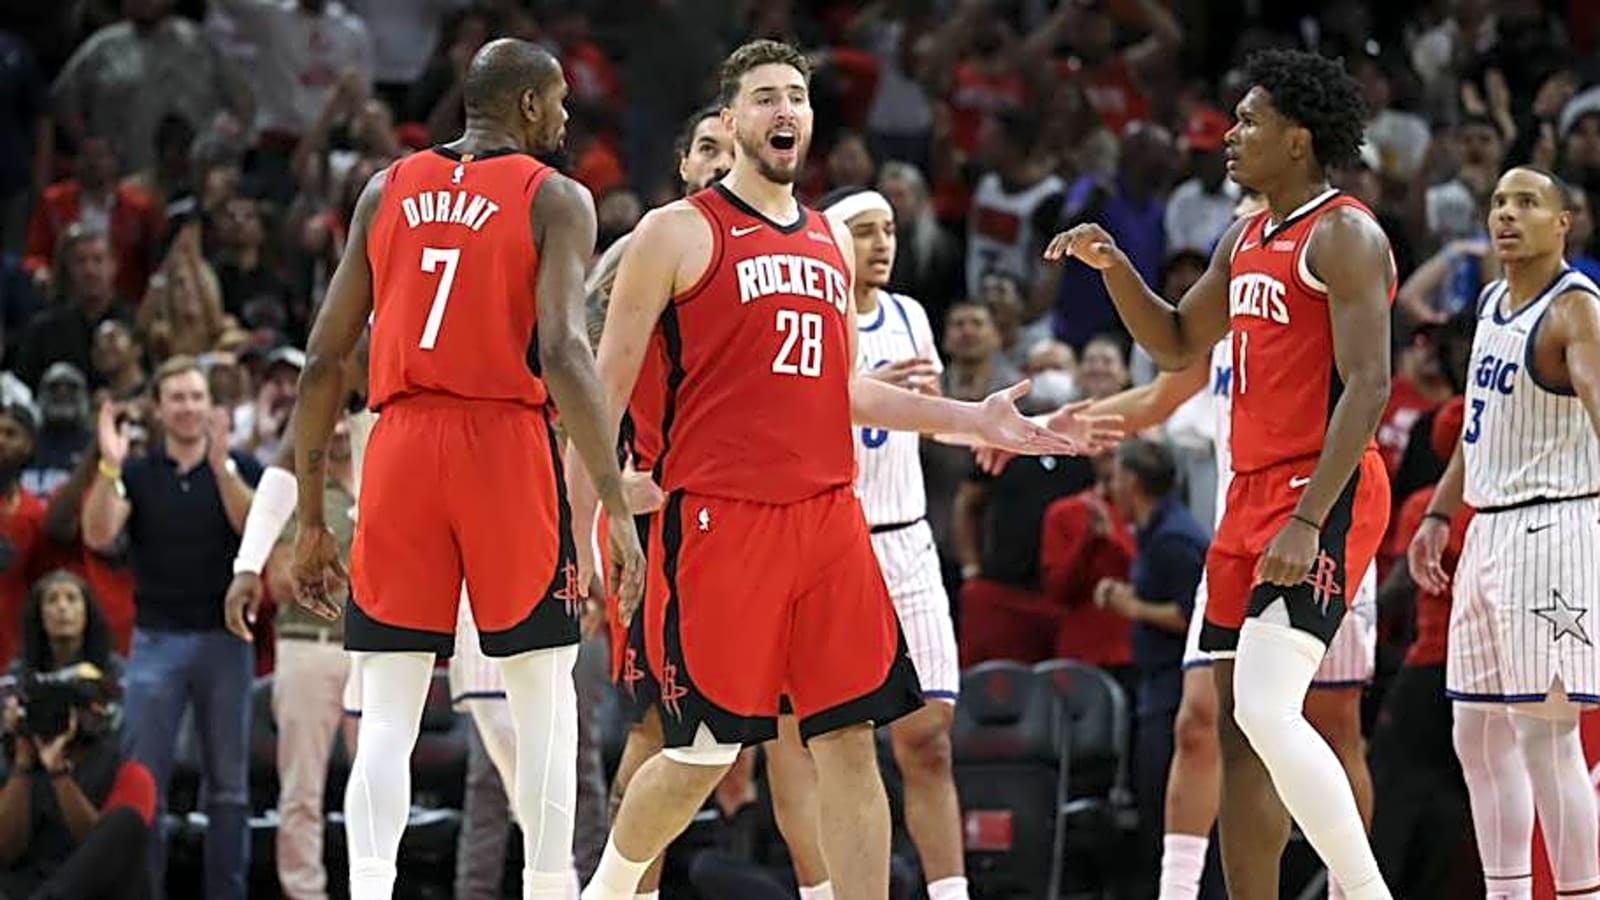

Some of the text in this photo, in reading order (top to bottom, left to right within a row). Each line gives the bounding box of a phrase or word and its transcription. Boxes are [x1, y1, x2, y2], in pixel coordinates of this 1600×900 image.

[402, 190, 500, 231] DURANT
[419, 247, 461, 350] 7
[736, 254, 847, 315] ROCKETS
[771, 309, 824, 377] 28
[1464, 398, 1485, 444] 3
